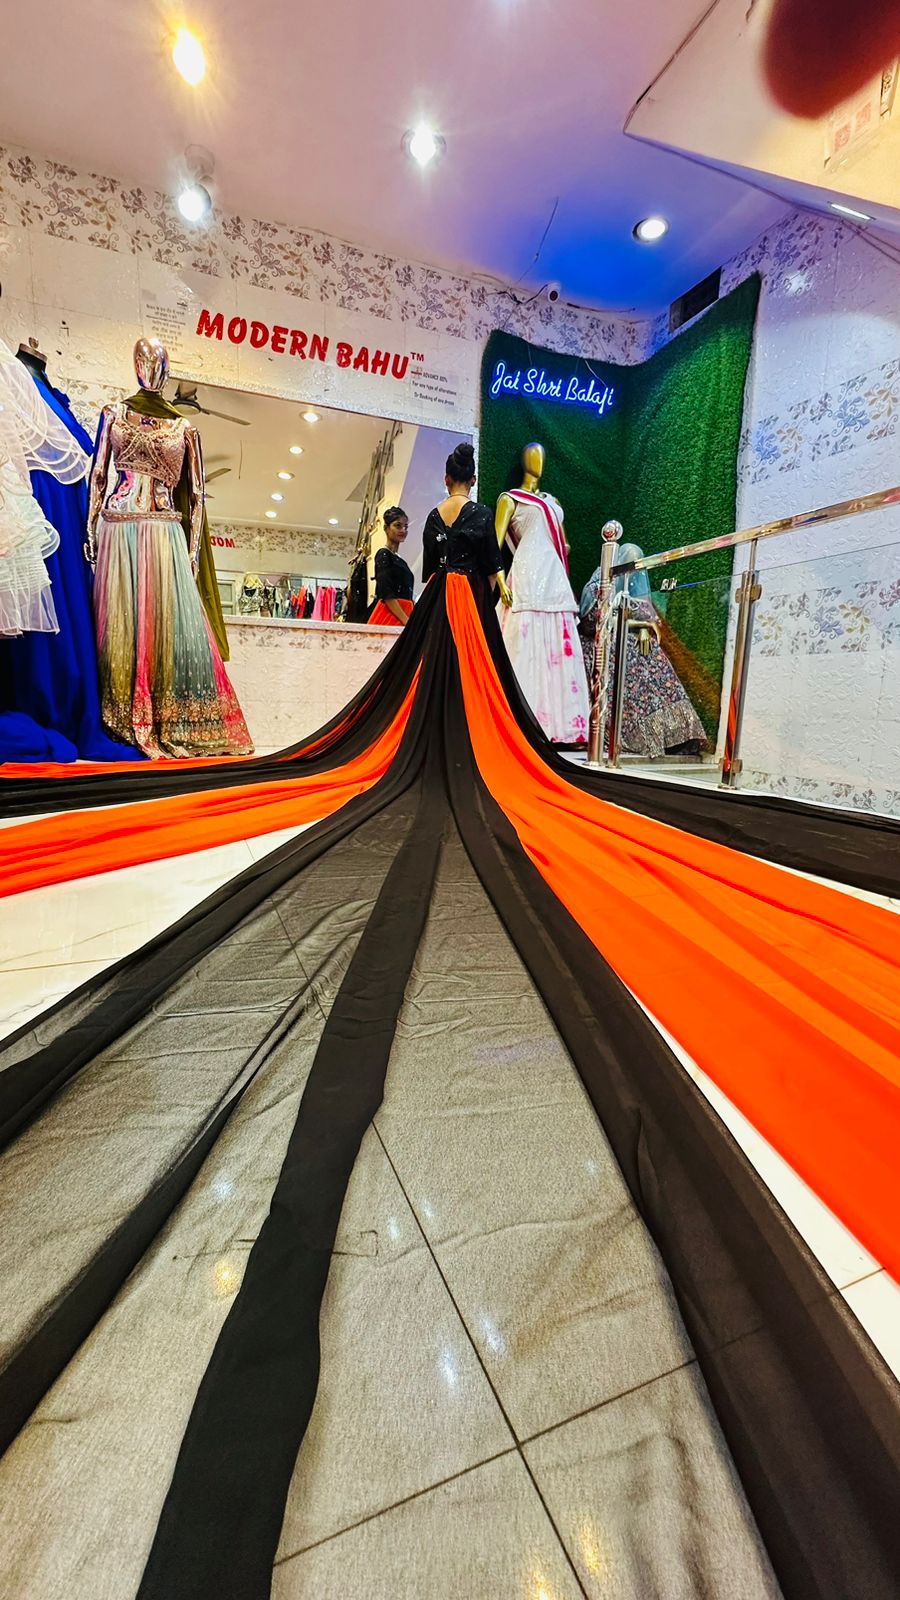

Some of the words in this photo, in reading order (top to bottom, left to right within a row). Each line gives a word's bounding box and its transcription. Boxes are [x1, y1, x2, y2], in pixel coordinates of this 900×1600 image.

[196, 309, 329, 361] MODERN
[336, 342, 409, 379] BAHU
[410, 352, 424, 361] TM
[491, 362, 520, 395] Jai
[523, 368, 562, 397] Shri
[564, 376, 615, 414] Balaji
